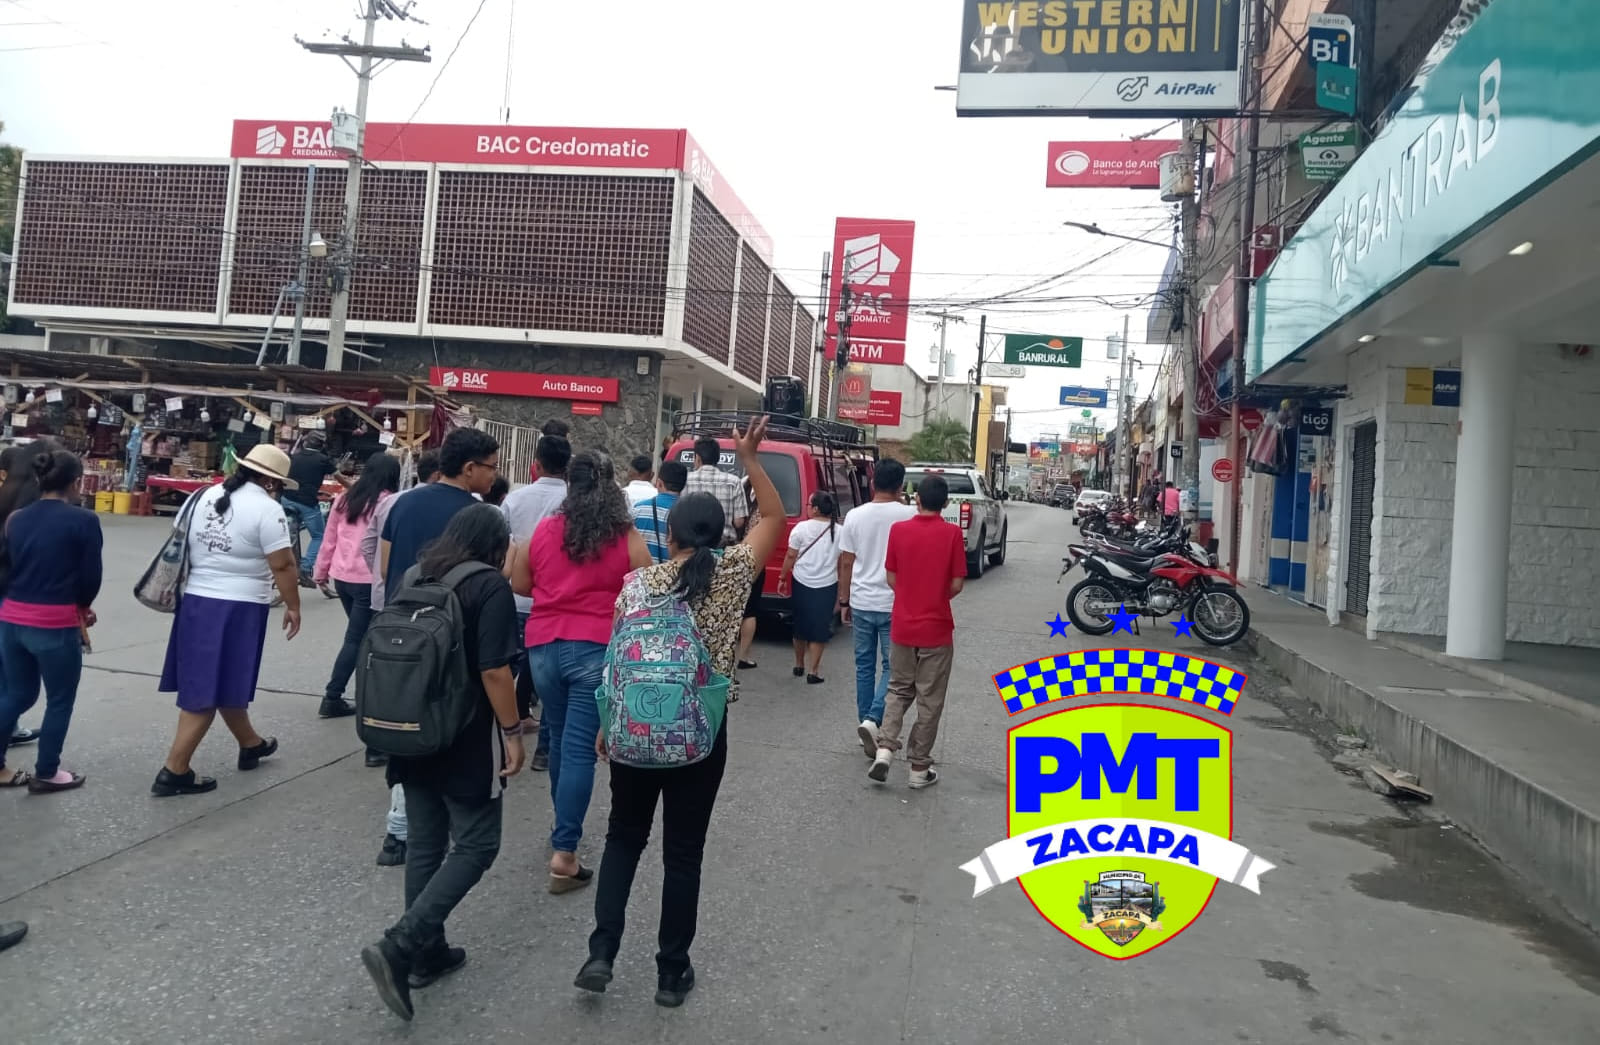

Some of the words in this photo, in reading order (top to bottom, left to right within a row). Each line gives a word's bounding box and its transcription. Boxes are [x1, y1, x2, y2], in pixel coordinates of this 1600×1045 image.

[977, 0, 1187, 28] WESTERN
[1041, 27, 1186, 54] UNION
[1312, 39, 1338, 62] Bi
[1154, 83, 1217, 96] AirPak
[477, 136, 520, 153] BAC
[525, 137, 649, 157] Credomatic
[1303, 135, 1344, 145] Agente
[1093, 159, 1122, 169] Banco
[1125, 159, 1137, 169] de
[1355, 58, 1501, 264] BANTRAB
[849, 343, 882, 358] ATM
[1018, 351, 1069, 364] BANRURAL
[462, 372, 488, 386] BAC
[543, 380, 568, 391] Auto
[570, 383, 603, 394] Banco
